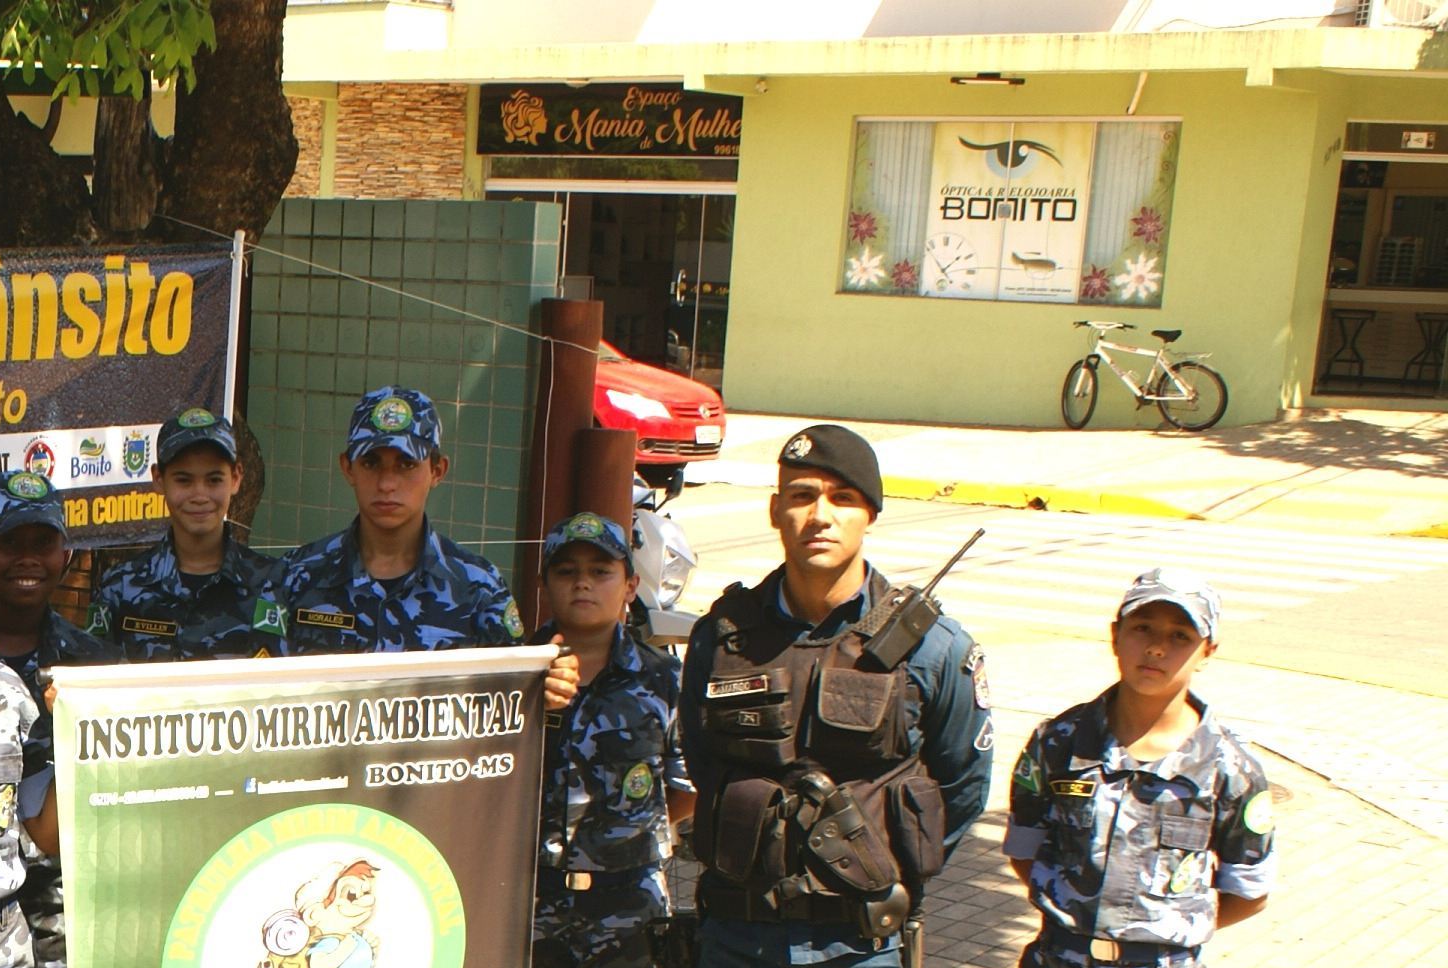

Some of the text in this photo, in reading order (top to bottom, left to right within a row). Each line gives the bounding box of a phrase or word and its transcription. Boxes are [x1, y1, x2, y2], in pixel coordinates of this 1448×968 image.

[622, 86, 681, 111] Espaço
[554, 108, 646, 150] Mania
[655, 108, 742, 151] Mulhe
[941, 184, 982, 196] ÓPTICA
[985, 188, 993, 196] &
[940, 197, 1077, 222] BONITO
[71, 455, 112, 478] Bonito
[308, 613, 344, 625] MORALES
[77, 692, 524, 764] INSTITUTO MIRIM AMBIENTAL
